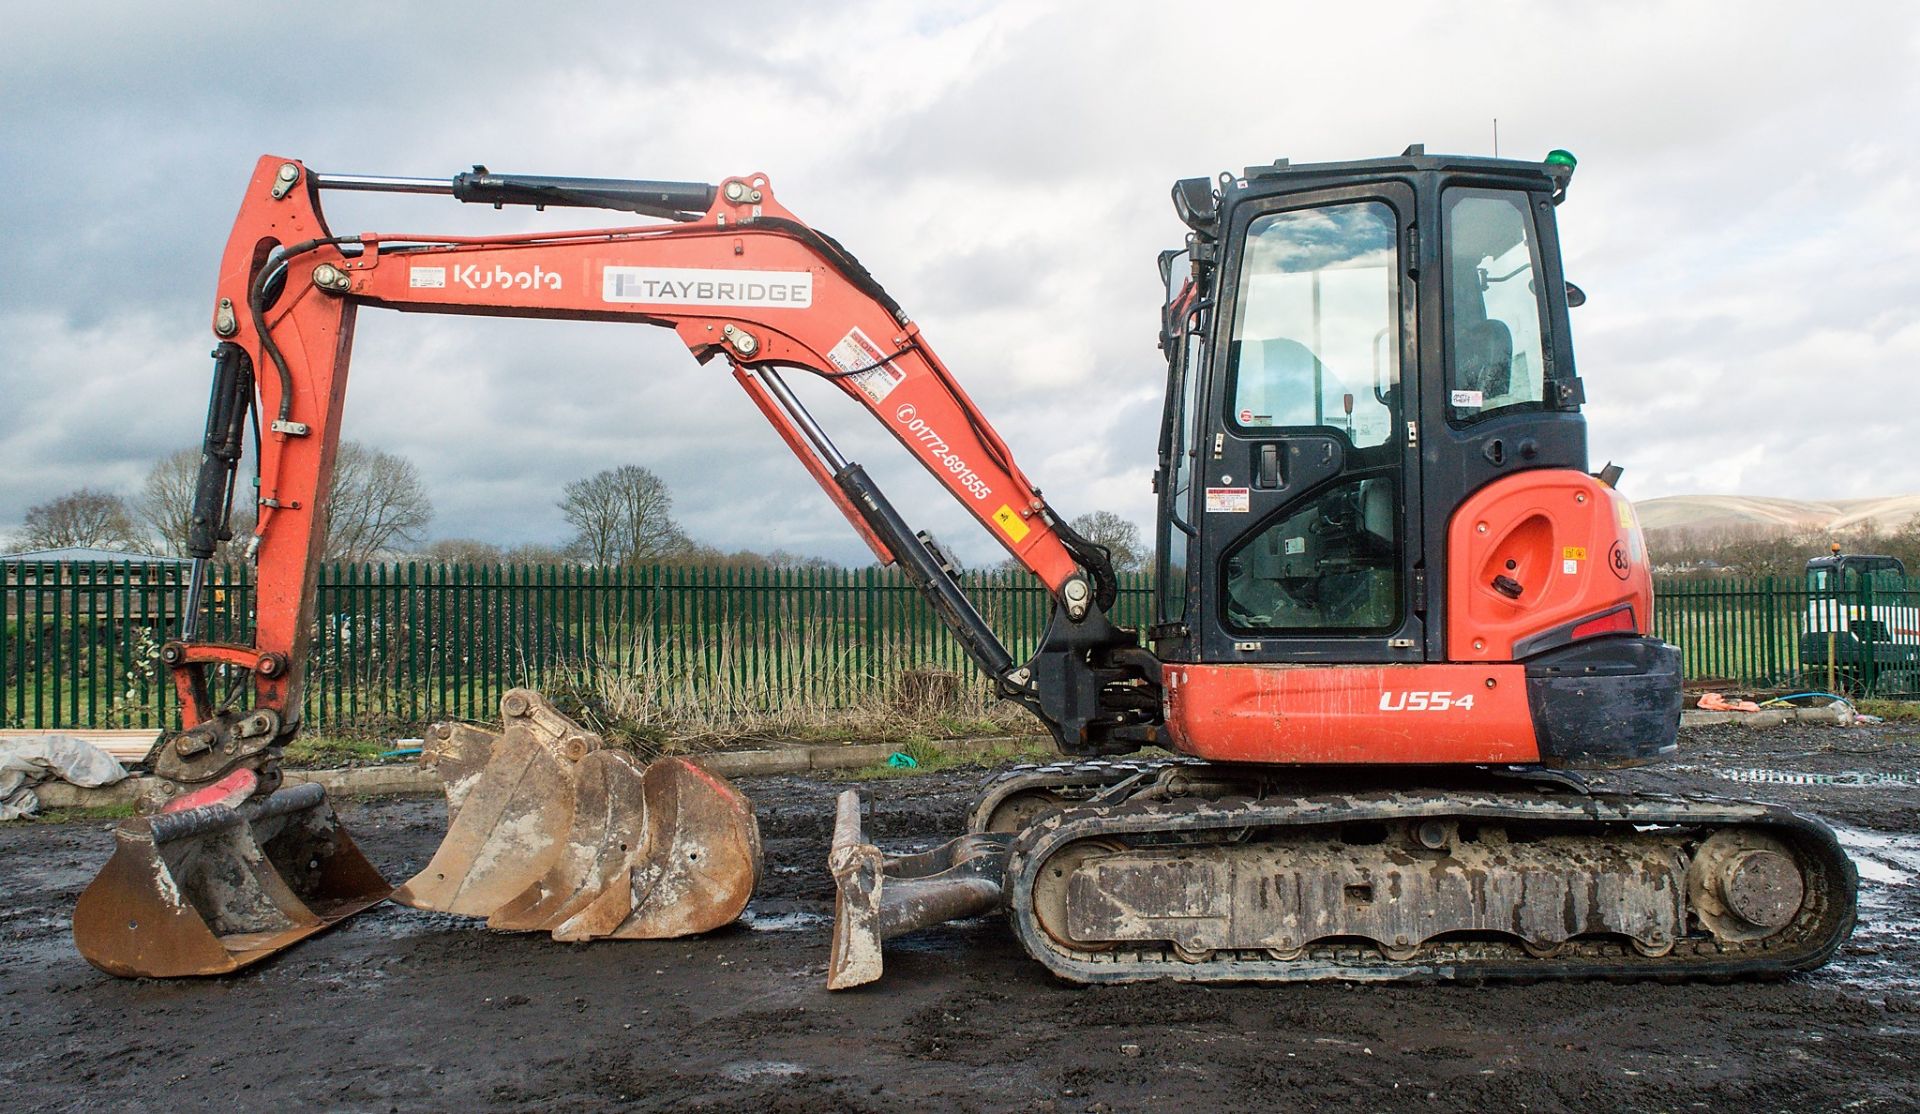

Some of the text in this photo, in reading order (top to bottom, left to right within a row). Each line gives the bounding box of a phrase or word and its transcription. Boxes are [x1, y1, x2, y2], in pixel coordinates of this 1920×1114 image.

[454, 264, 563, 290] Kubota
[642, 280, 808, 302] TAYBRIDGE
[850, 330, 874, 353] STOP
[909, 418, 992, 500] 01772-691555
[1379, 691, 1475, 711] U55-4
